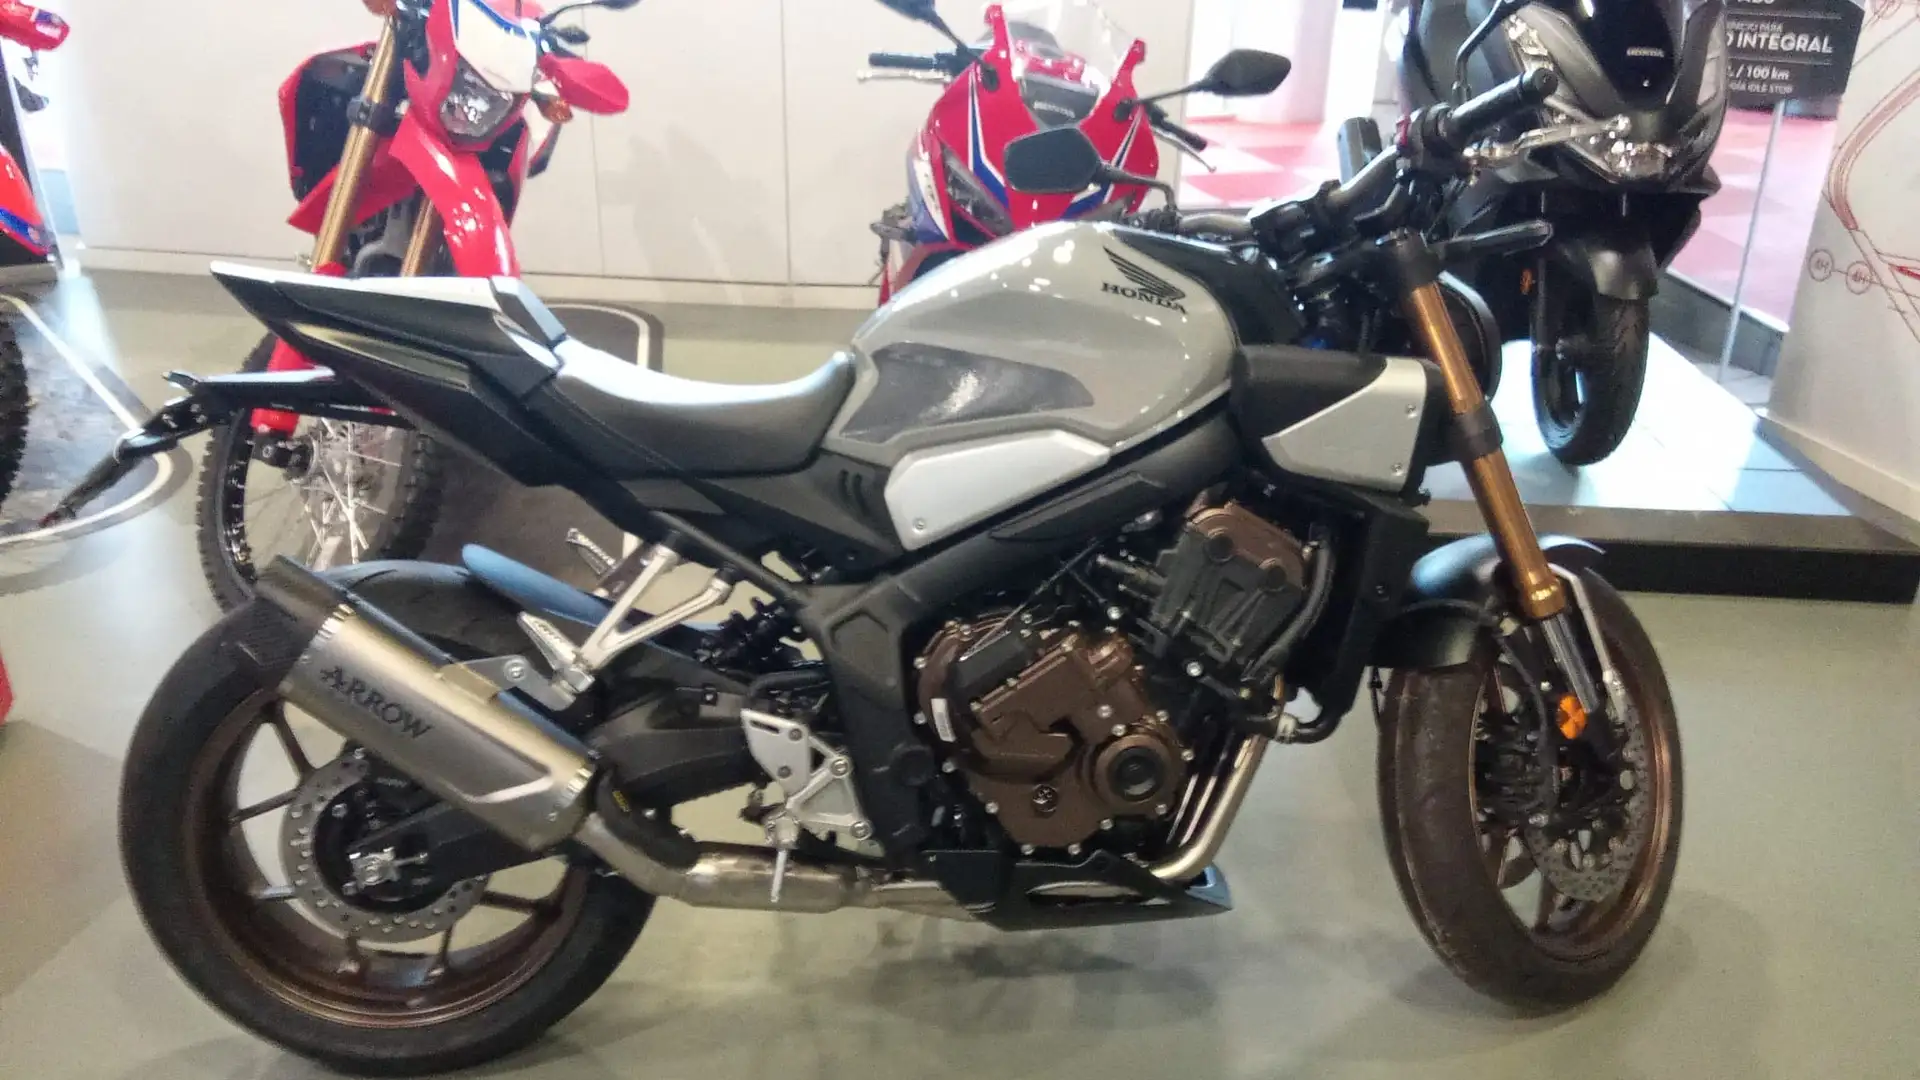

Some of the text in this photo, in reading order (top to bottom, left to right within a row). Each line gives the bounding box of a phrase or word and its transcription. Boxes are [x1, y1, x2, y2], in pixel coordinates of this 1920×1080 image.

[1736, 32, 1833, 54] INTEGRAL
[1747, 64, 1770, 79] 100
[1771, 65, 1790, 80] km
[1101, 282, 1187, 315] HONDA
[319, 666, 433, 739] ARROW
